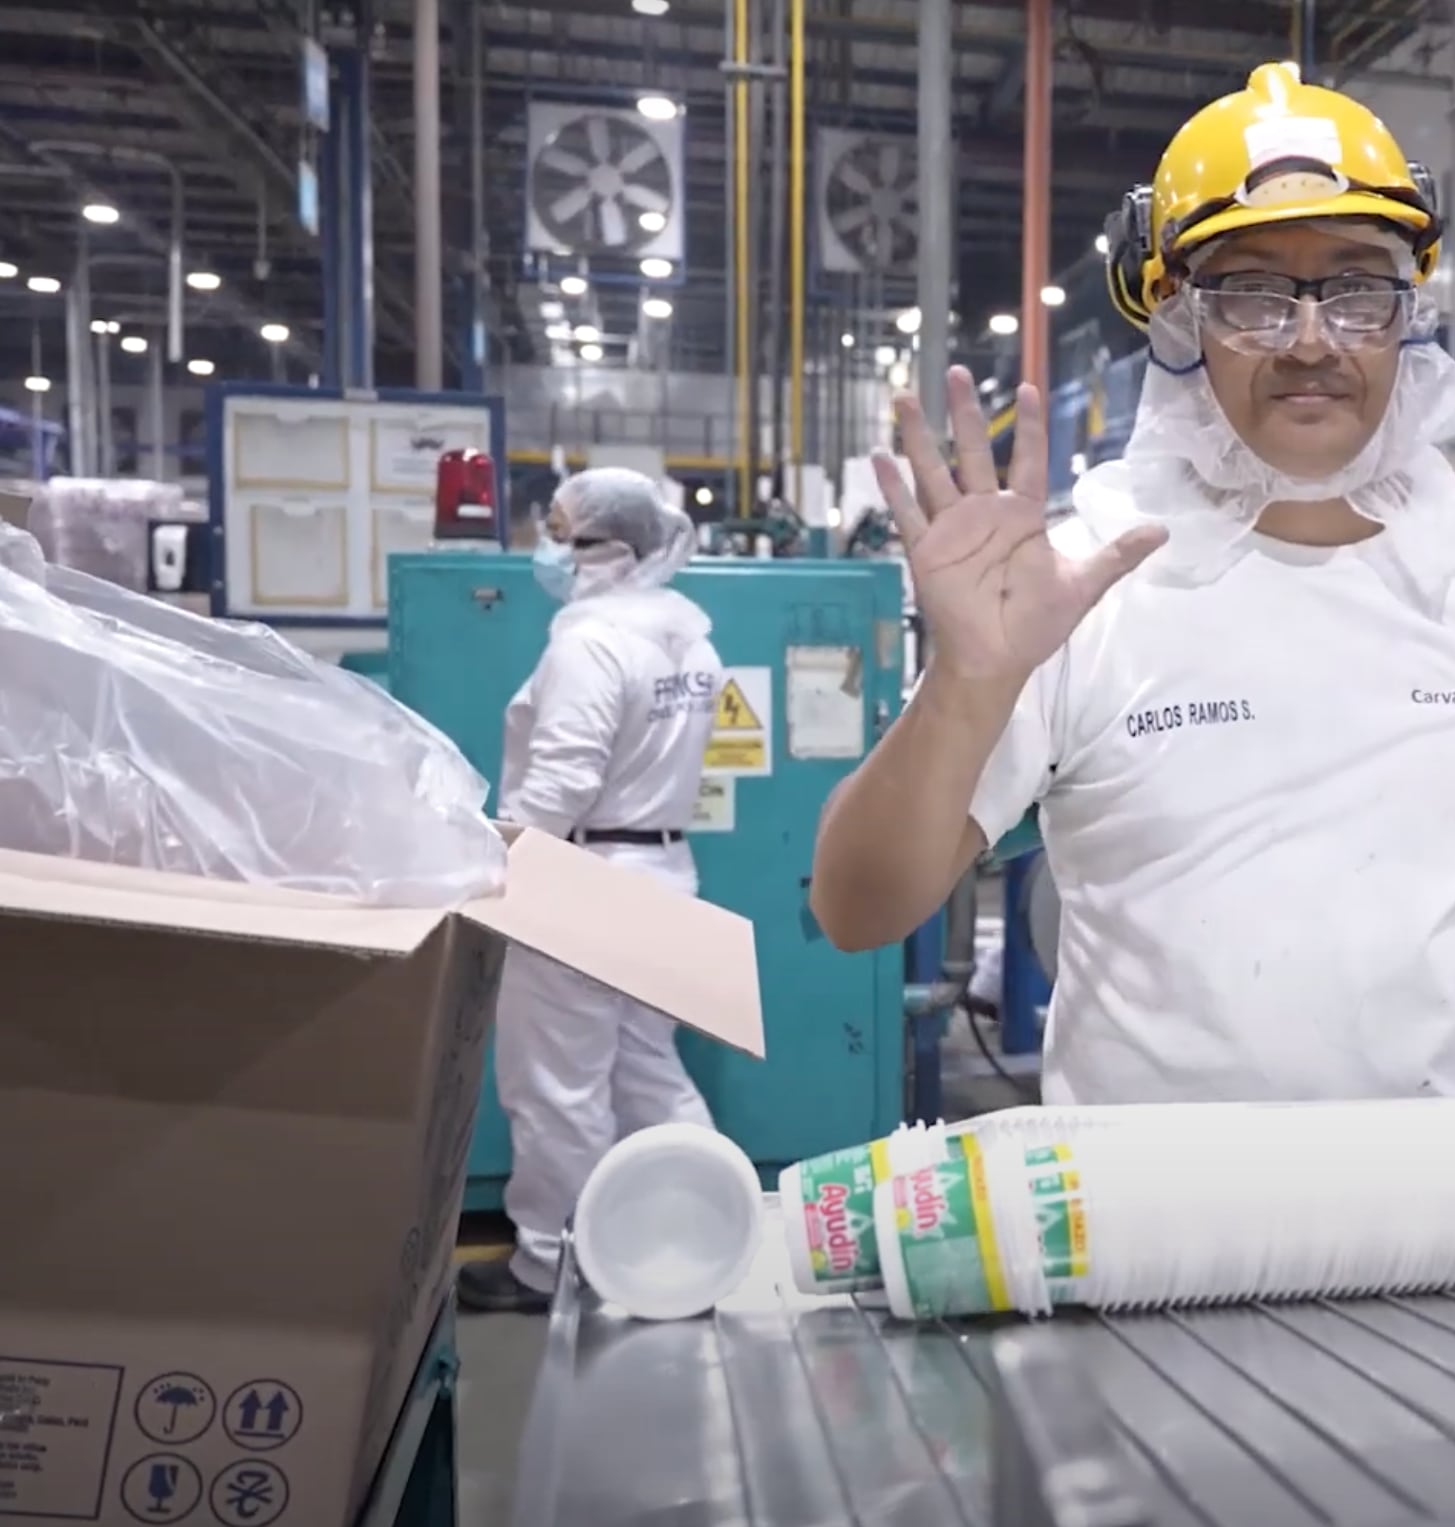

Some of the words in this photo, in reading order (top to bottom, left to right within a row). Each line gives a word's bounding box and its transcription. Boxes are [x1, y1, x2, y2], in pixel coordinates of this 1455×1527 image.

[1126, 704, 1183, 737] CARLOS
[1189, 701, 1239, 725] RAMOS
[1241, 700, 1255, 721] S.
